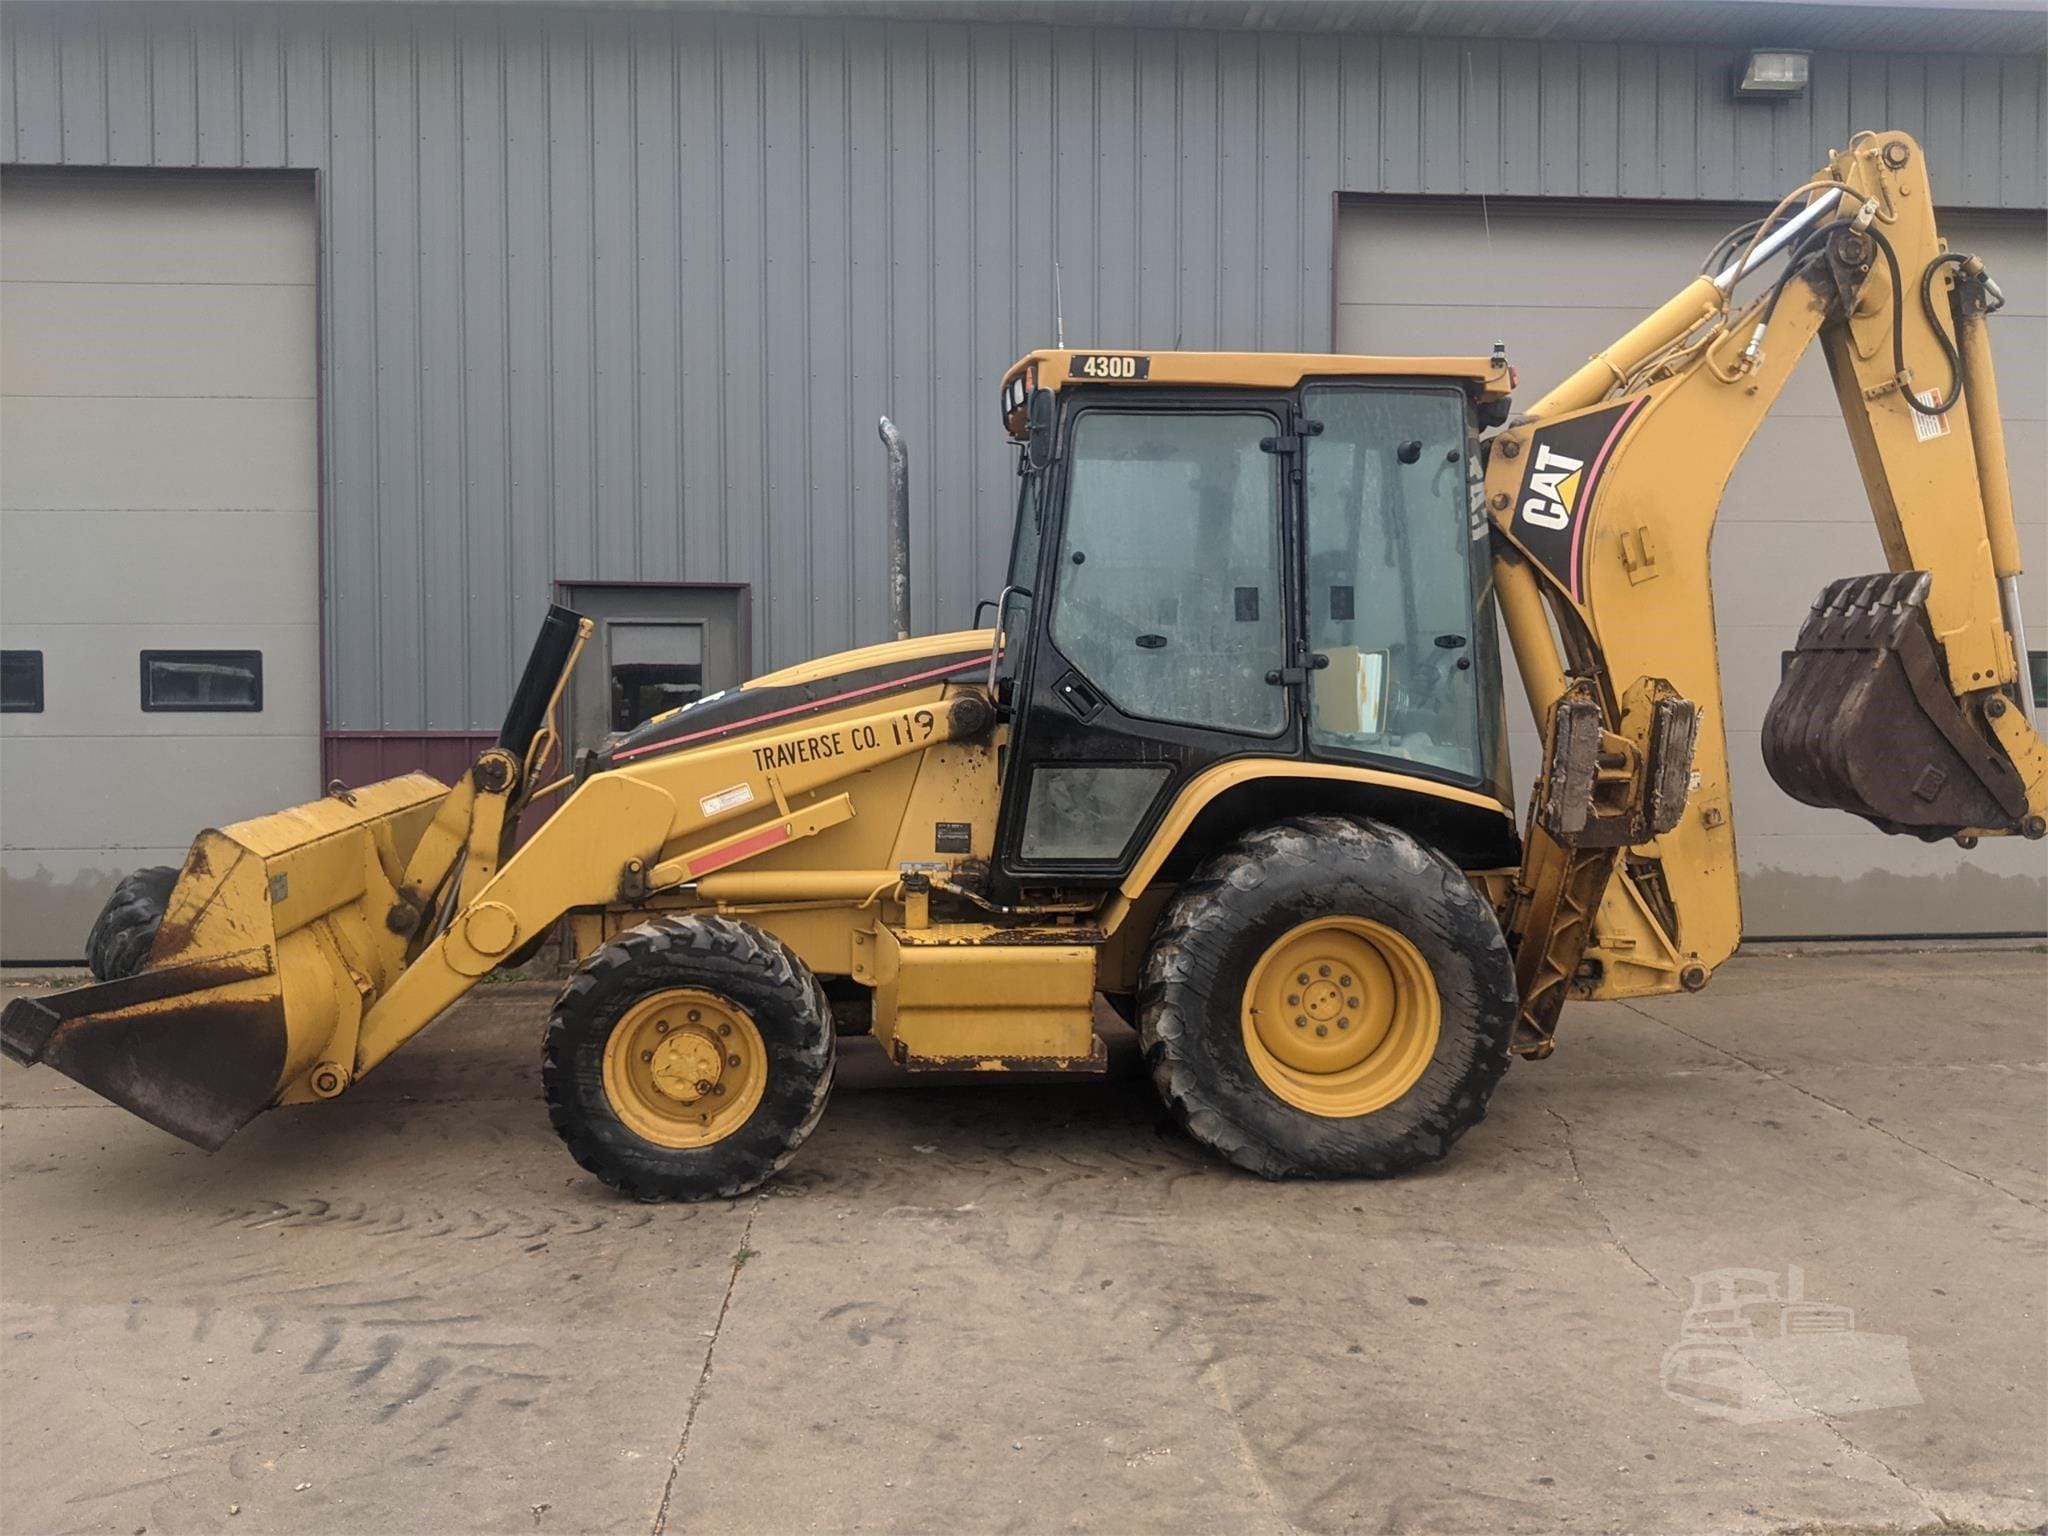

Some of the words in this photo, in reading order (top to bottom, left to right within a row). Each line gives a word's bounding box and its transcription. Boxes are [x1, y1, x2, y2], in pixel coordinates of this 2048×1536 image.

[1083, 356, 1136, 377] 430D
[1522, 443, 1584, 530] CAT
[753, 733, 844, 771] TRAVERSE
[851, 725, 880, 751] CO.
[892, 710, 934, 745] 119
